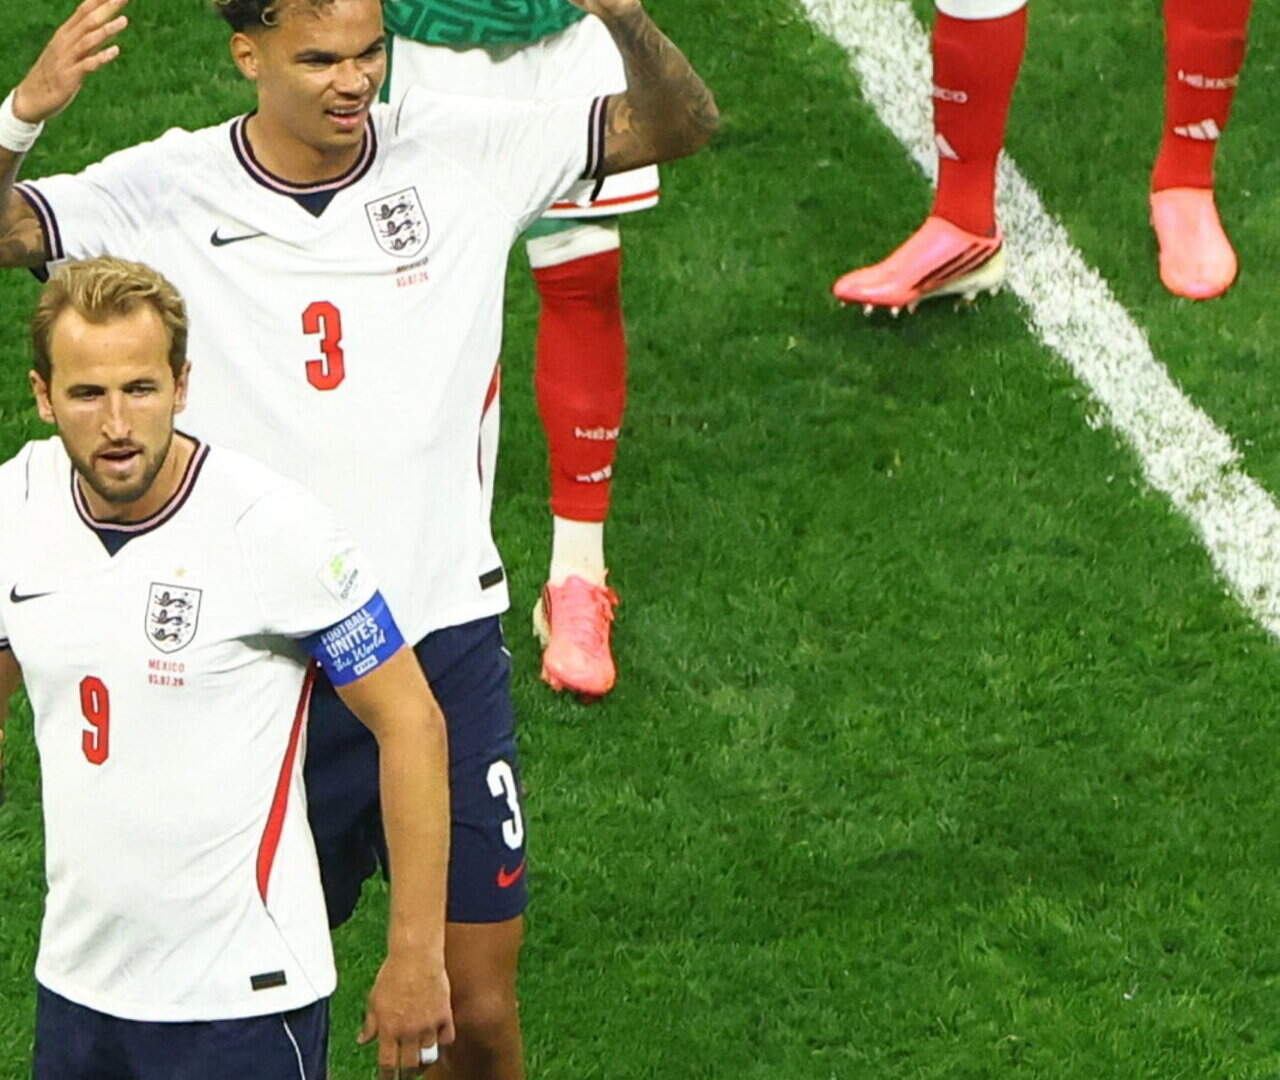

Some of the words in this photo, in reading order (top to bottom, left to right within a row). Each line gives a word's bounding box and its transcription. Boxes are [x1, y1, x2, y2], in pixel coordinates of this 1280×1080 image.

[302, 300, 345, 391] 3
[321, 607, 372, 646] FOOTBALL
[326, 617, 379, 659] UNITES
[351, 628, 386, 663] World
[148, 658, 185, 673] MEXICO
[79, 675, 110, 766] 9
[486, 760, 524, 850] 3
